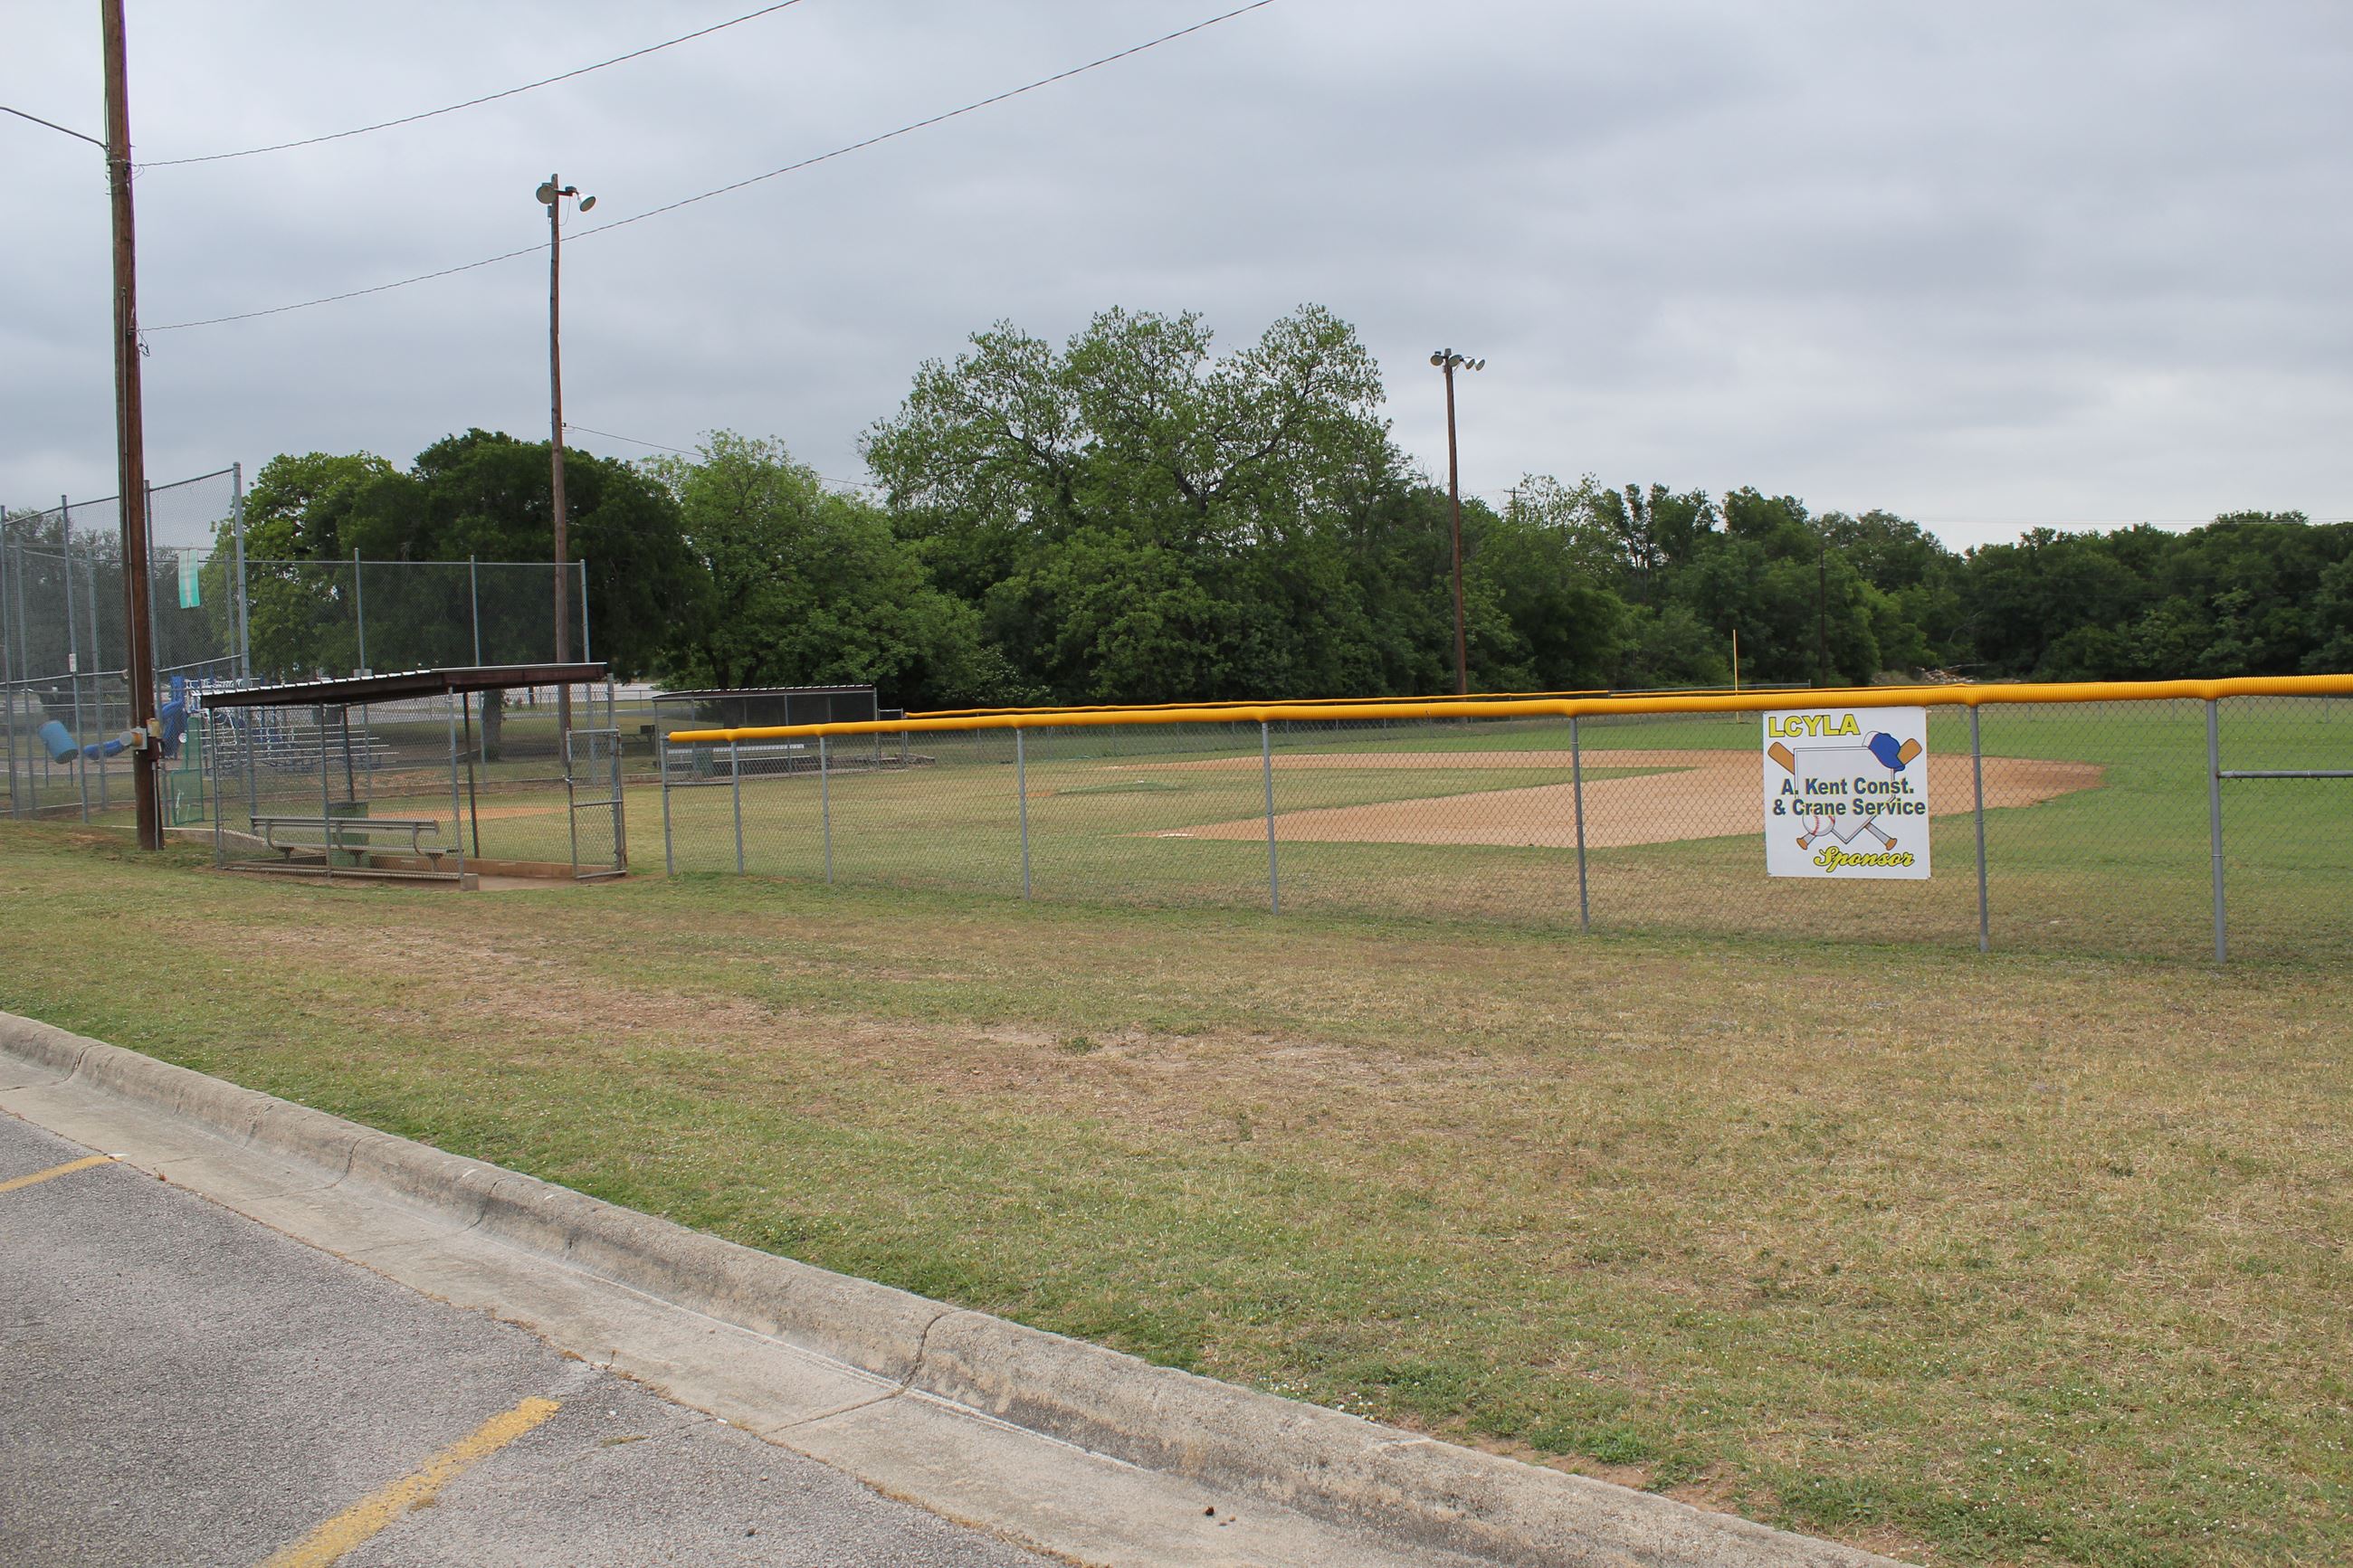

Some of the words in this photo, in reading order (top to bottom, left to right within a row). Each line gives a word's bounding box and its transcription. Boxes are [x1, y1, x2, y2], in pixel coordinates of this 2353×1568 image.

[1768, 714, 1861, 737] LCYLA
[1781, 778, 1799, 795] A.
[1805, 778, 1848, 795] Kent
[1854, 777, 1914, 795] Const.
[1773, 799, 1786, 815] &
[1793, 798, 1846, 815] Crane
[1853, 797, 1926, 815] Service
[1814, 846, 1915, 873] Sponsor
